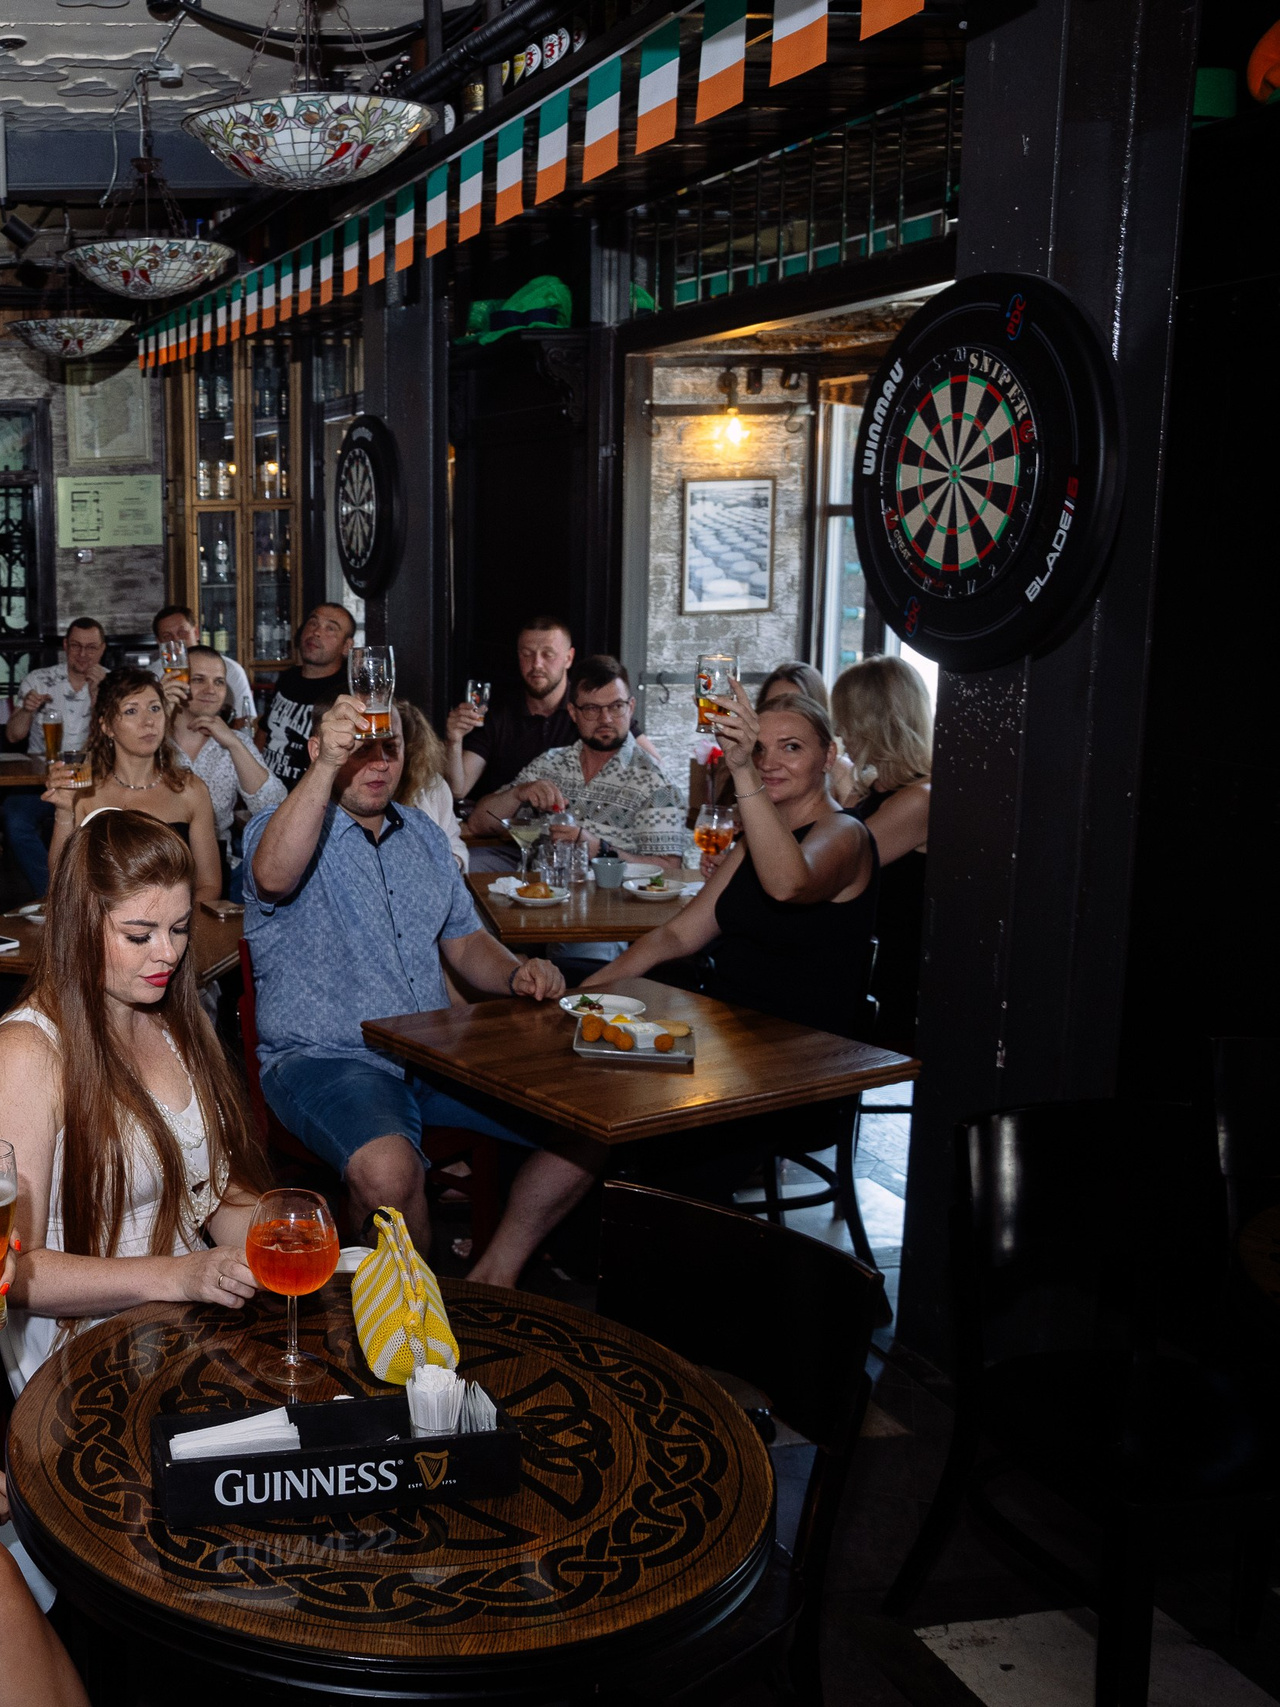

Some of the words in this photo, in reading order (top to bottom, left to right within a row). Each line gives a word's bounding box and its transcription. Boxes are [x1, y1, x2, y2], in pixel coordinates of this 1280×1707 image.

[1006, 298, 1027, 337] PDC
[969, 352, 1031, 421] SNIPER
[862, 361, 904, 475] WINMAU
[893, 529, 912, 561] GREAT
[214, 1459, 399, 1507] GUINNESS
